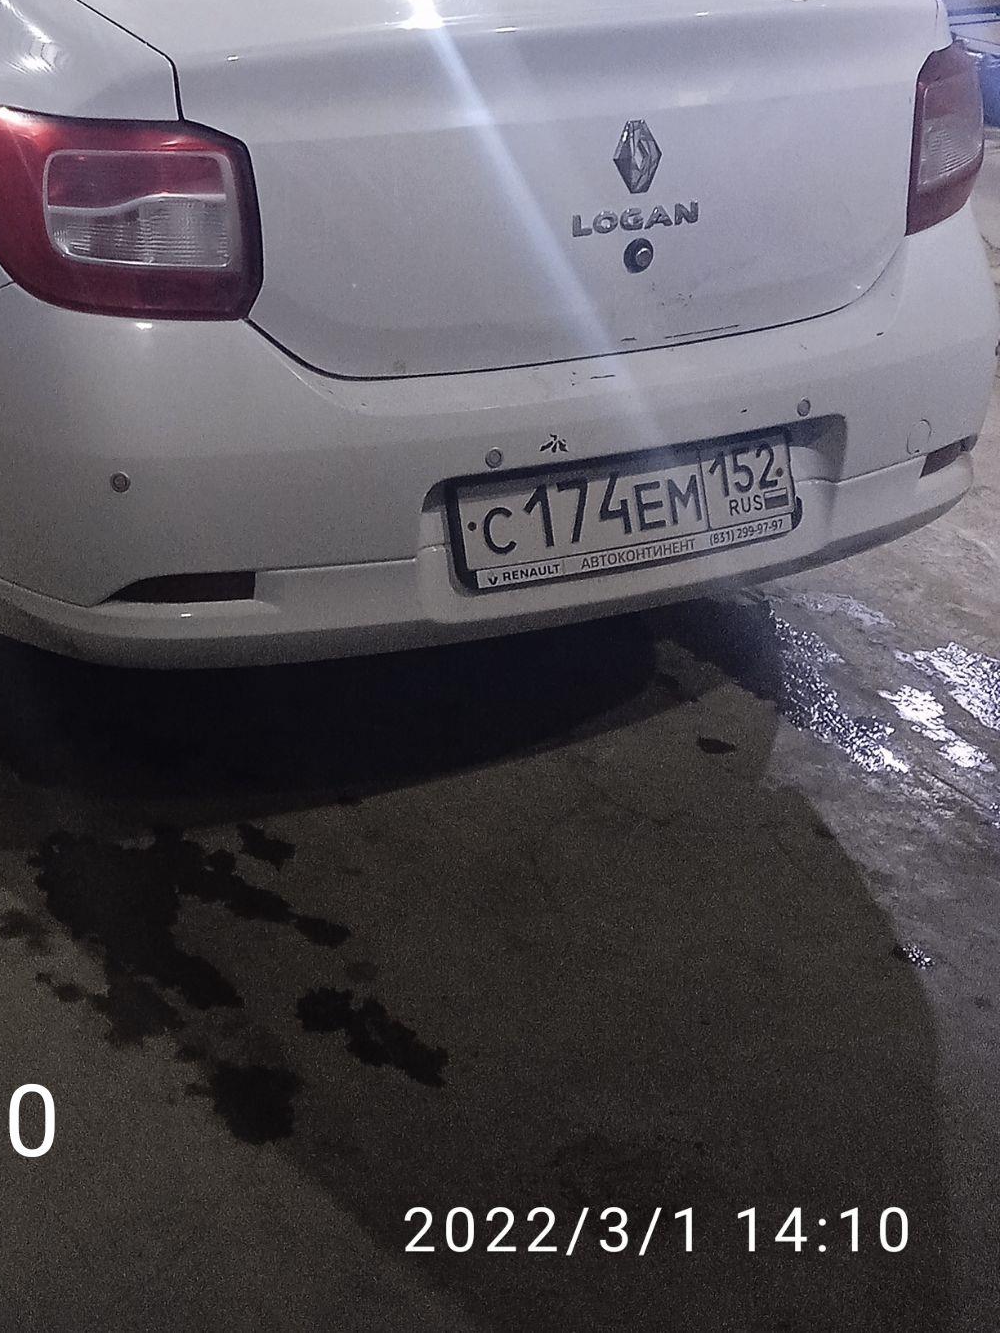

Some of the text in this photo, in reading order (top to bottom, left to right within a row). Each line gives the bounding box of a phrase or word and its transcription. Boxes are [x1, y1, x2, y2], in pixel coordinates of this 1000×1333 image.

[571, 199, 699, 238] LOGAN
[708, 442, 779, 498] 152
[728, 495, 764, 517] RUS
[502, 518, 784, 581] RENAULT АВТОКОНТИНЕНТ (831) 299-97-97
